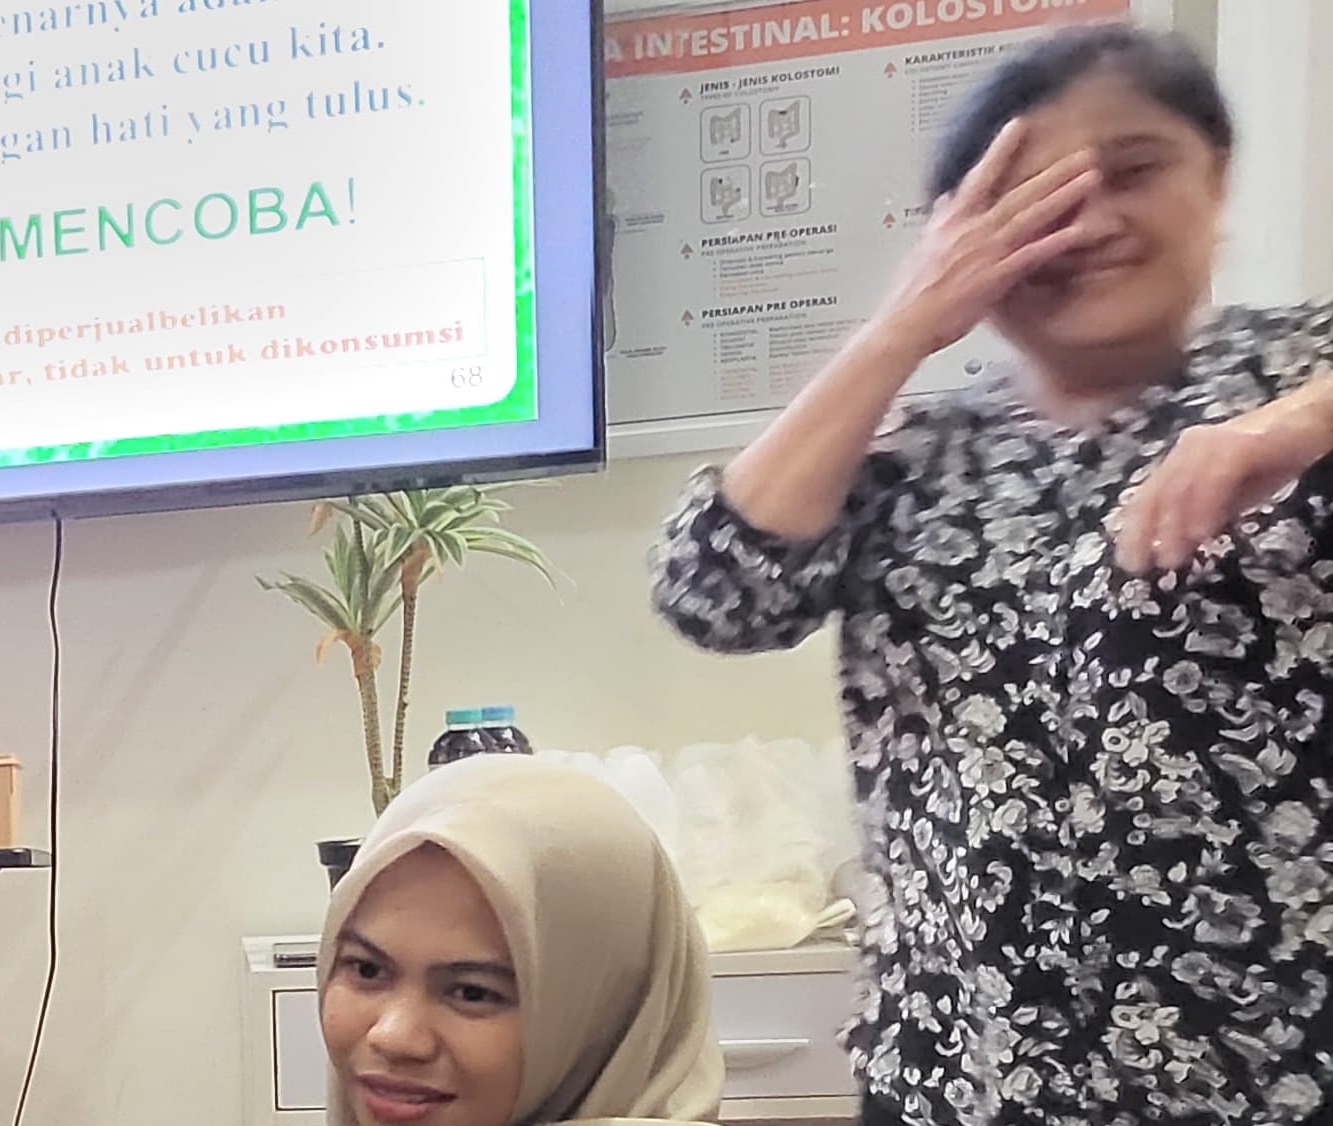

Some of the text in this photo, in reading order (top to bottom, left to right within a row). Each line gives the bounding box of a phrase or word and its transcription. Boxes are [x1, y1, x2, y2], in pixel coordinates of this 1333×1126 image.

[54, 47, 155, 90] anak
[172, 39, 270, 75] cucu
[289, 22, 386, 60] kita.
[633, 13, 850, 60] INTESTINAL:
[699, 80, 731, 95] JENIS
[738, 75, 769, 90] JENIS
[771, 66, 841, 84] KOLOSTOMI
[91, 105, 170, 145] hati
[186, 100, 289, 144] yang
[305, 80, 426, 120] tulus.
[700, 233, 764, 249] PERSIAPAN
[789, 224, 838, 239] OPERASI
[3, 302, 287, 349] diperjualbelikan
[700, 296, 838, 319] PERSIAPAN PRE OPERASI
[44, 354, 131, 384] tidak
[144, 344, 247, 374] untuk
[259, 320, 466, 362] dikonsumsi
[449, 364, 485, 390] 68
